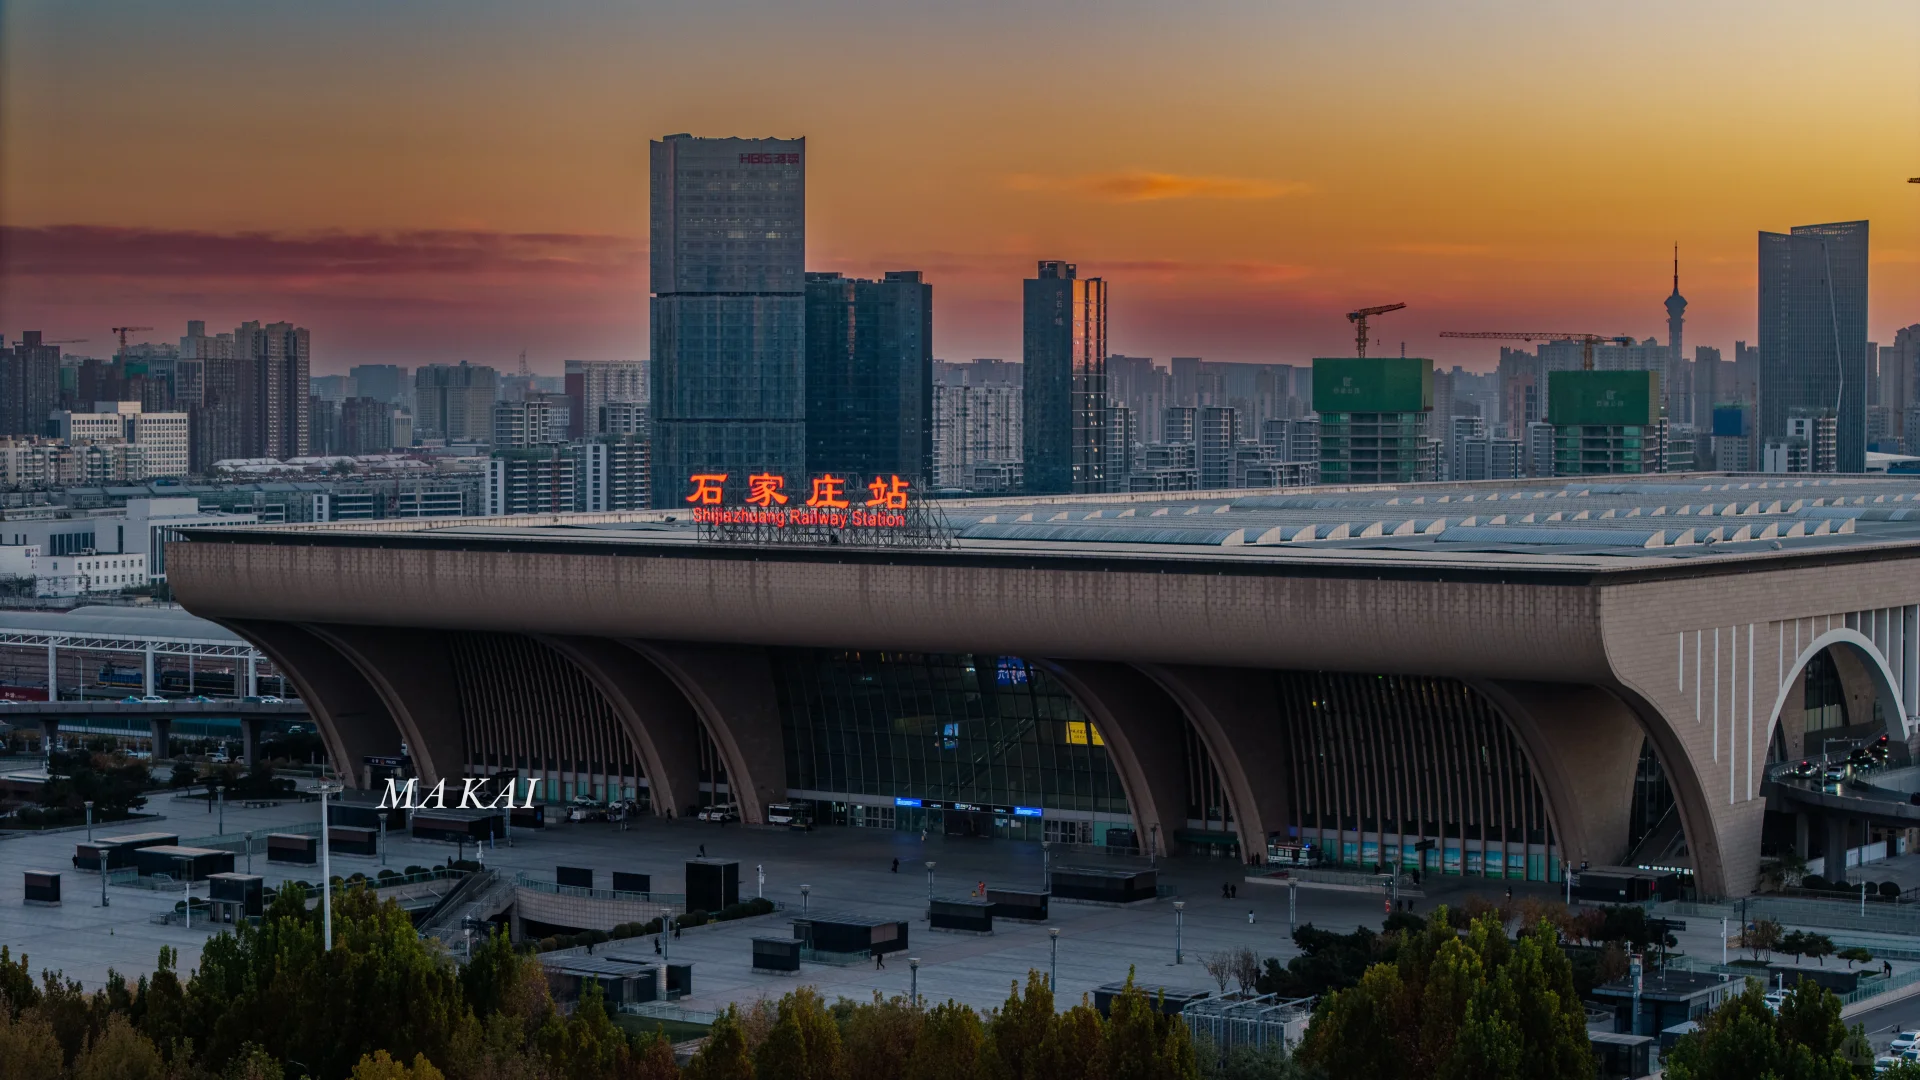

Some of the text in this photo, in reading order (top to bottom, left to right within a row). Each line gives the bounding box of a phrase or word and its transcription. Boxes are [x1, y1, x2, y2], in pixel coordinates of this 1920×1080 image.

[740, 153, 772, 164] HBIS
[685, 473, 910, 509] 石家庄站
[692, 506, 906, 530] Shijiazhuang Railway Station
